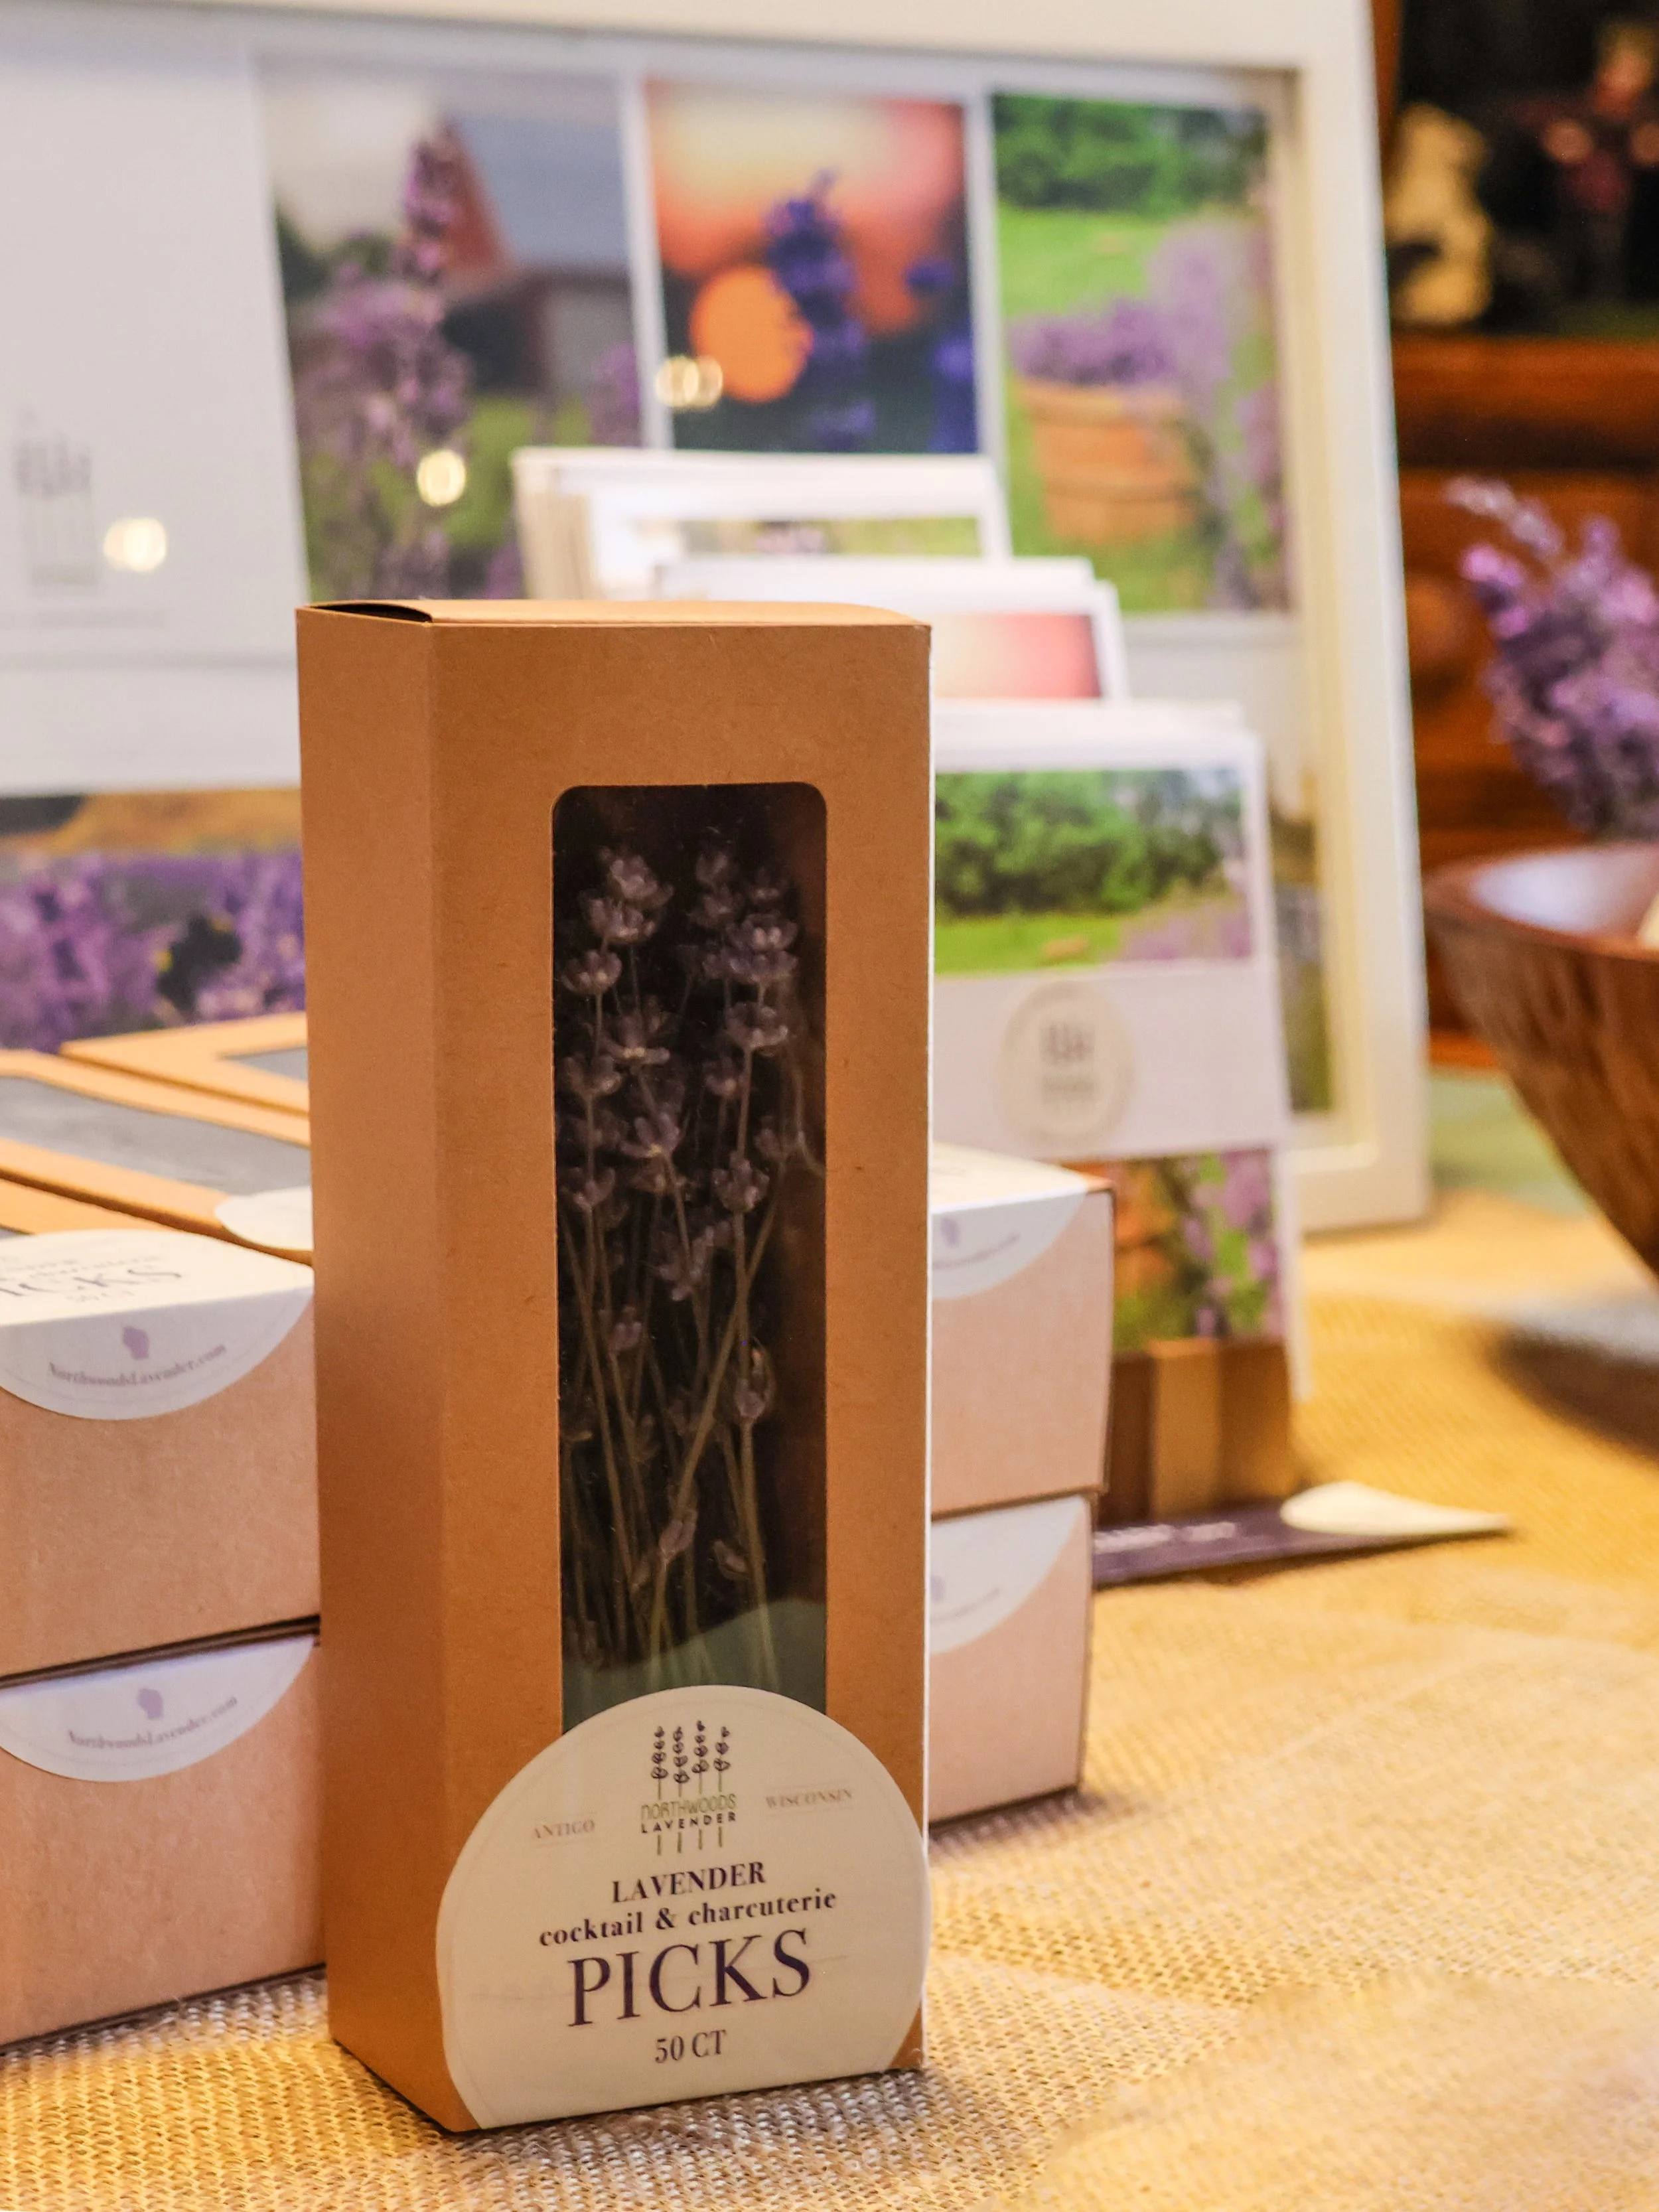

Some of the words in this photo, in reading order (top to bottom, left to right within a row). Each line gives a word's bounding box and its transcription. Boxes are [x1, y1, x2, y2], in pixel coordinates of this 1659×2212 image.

[533, 1819, 595, 1840] ANTIGO
[641, 1811, 736, 1834] LAVENDER
[612, 1861, 766, 1903] LAVENDER
[540, 1911, 644, 1947] cocktail
[654, 1908, 676, 1931] &
[689, 1888, 837, 1926] charcuterie
[568, 1928, 812, 2028] PICKS
[655, 2035, 685, 2065] 50
[691, 2029, 727, 2058] CT
